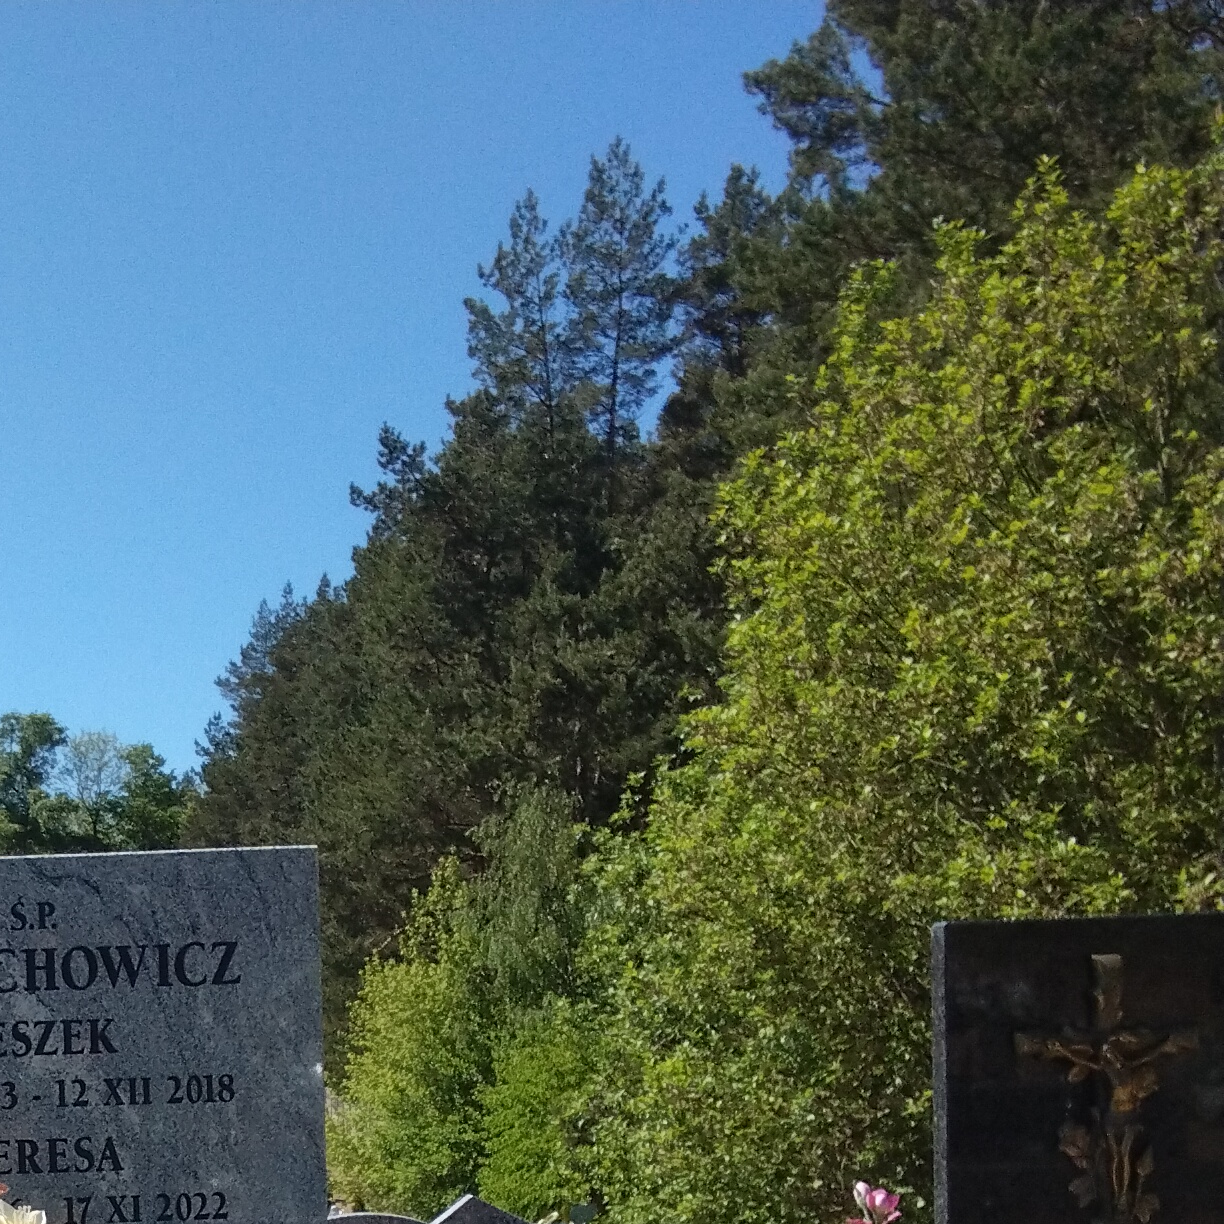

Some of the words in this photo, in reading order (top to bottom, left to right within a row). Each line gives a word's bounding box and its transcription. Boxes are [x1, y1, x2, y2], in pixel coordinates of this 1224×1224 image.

[56, 1078, 89, 1109] 12
[103, 1077, 152, 1107] XII
[167, 1073, 236, 1105] 2018
[105, 1194, 143, 1224] XI
[156, 1191, 230, 1223] 2022
